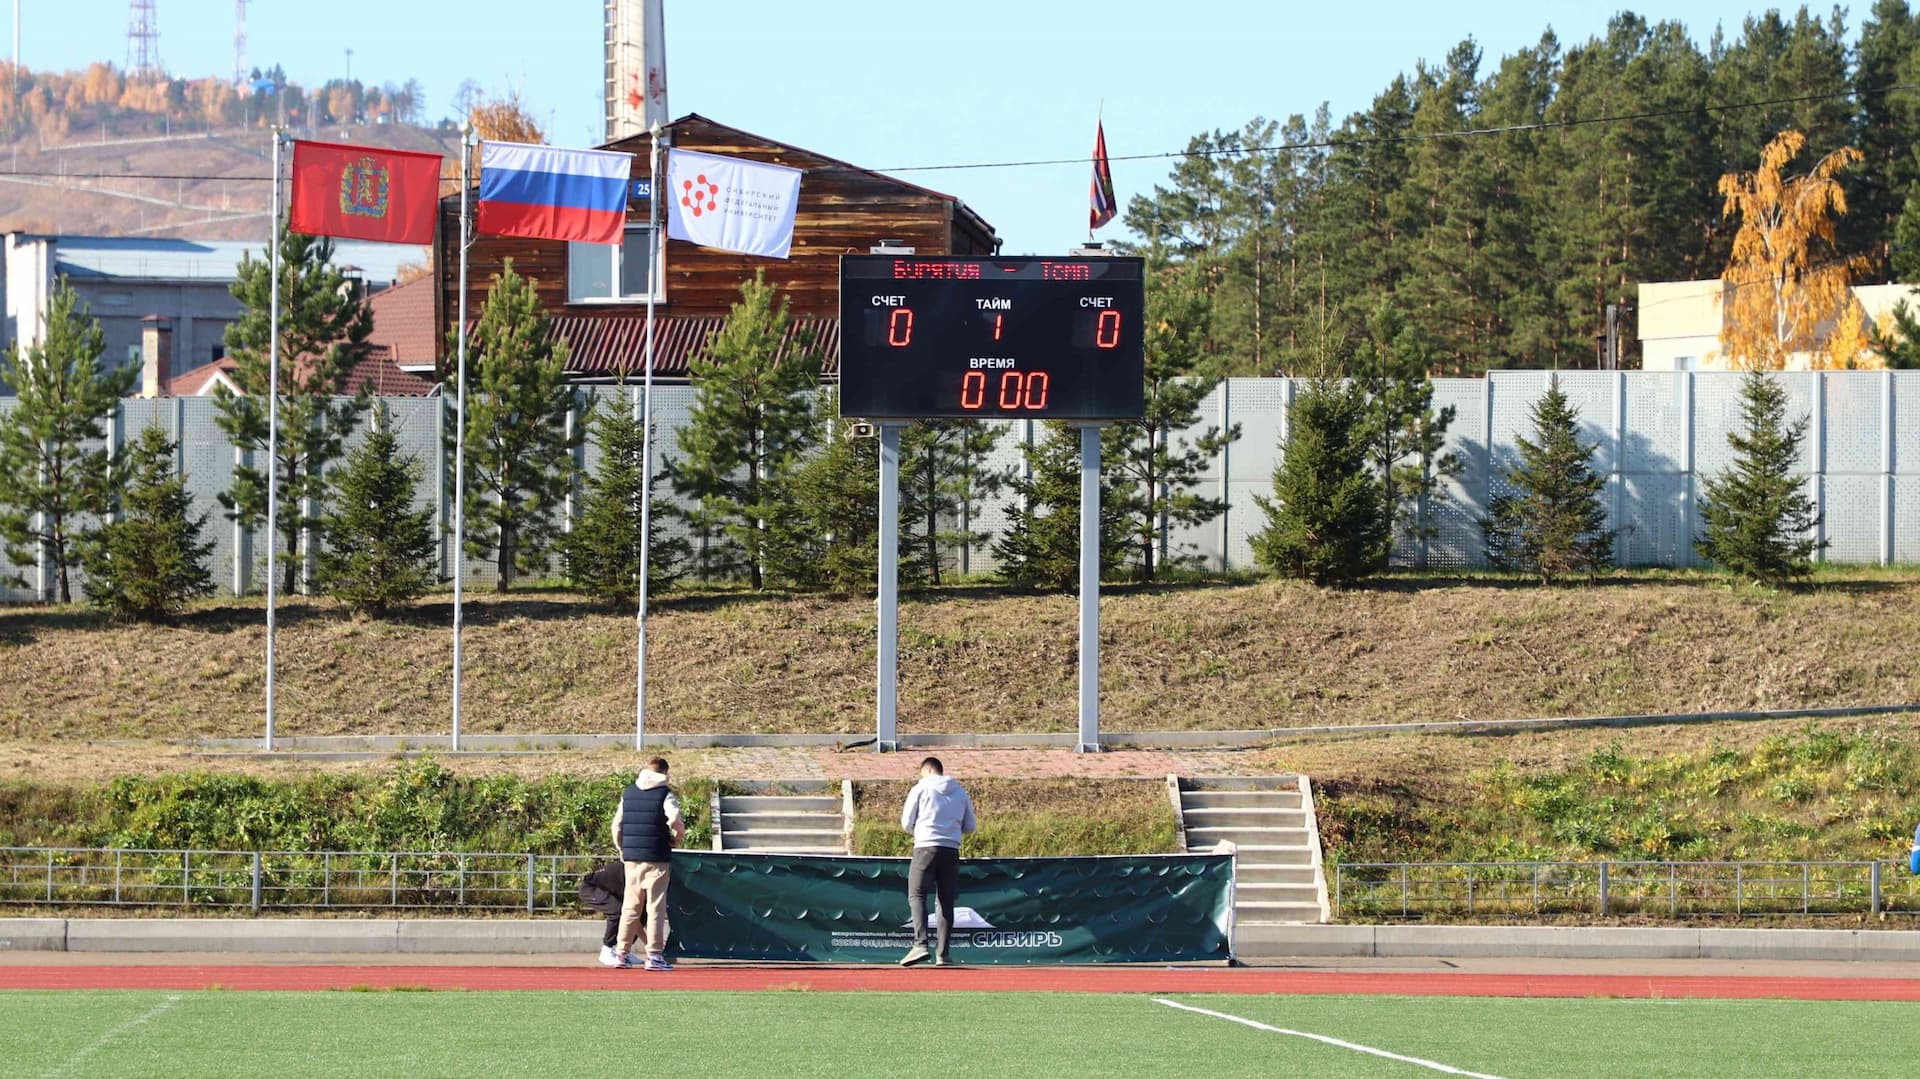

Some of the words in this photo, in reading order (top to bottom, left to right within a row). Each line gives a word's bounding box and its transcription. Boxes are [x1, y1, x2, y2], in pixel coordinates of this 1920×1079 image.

[637, 183, 650, 196] 25
[871, 295, 906, 306] СЧЕТ
[975, 296, 1012, 310] ТАЙМ
[1079, 296, 1114, 308] СЧЕТ
[888, 309, 913, 347] 0
[1096, 310, 1121, 348] 0
[969, 357, 1016, 369] ВРЕМЯ
[972, 931, 1063, 948] СИБИРЬ
